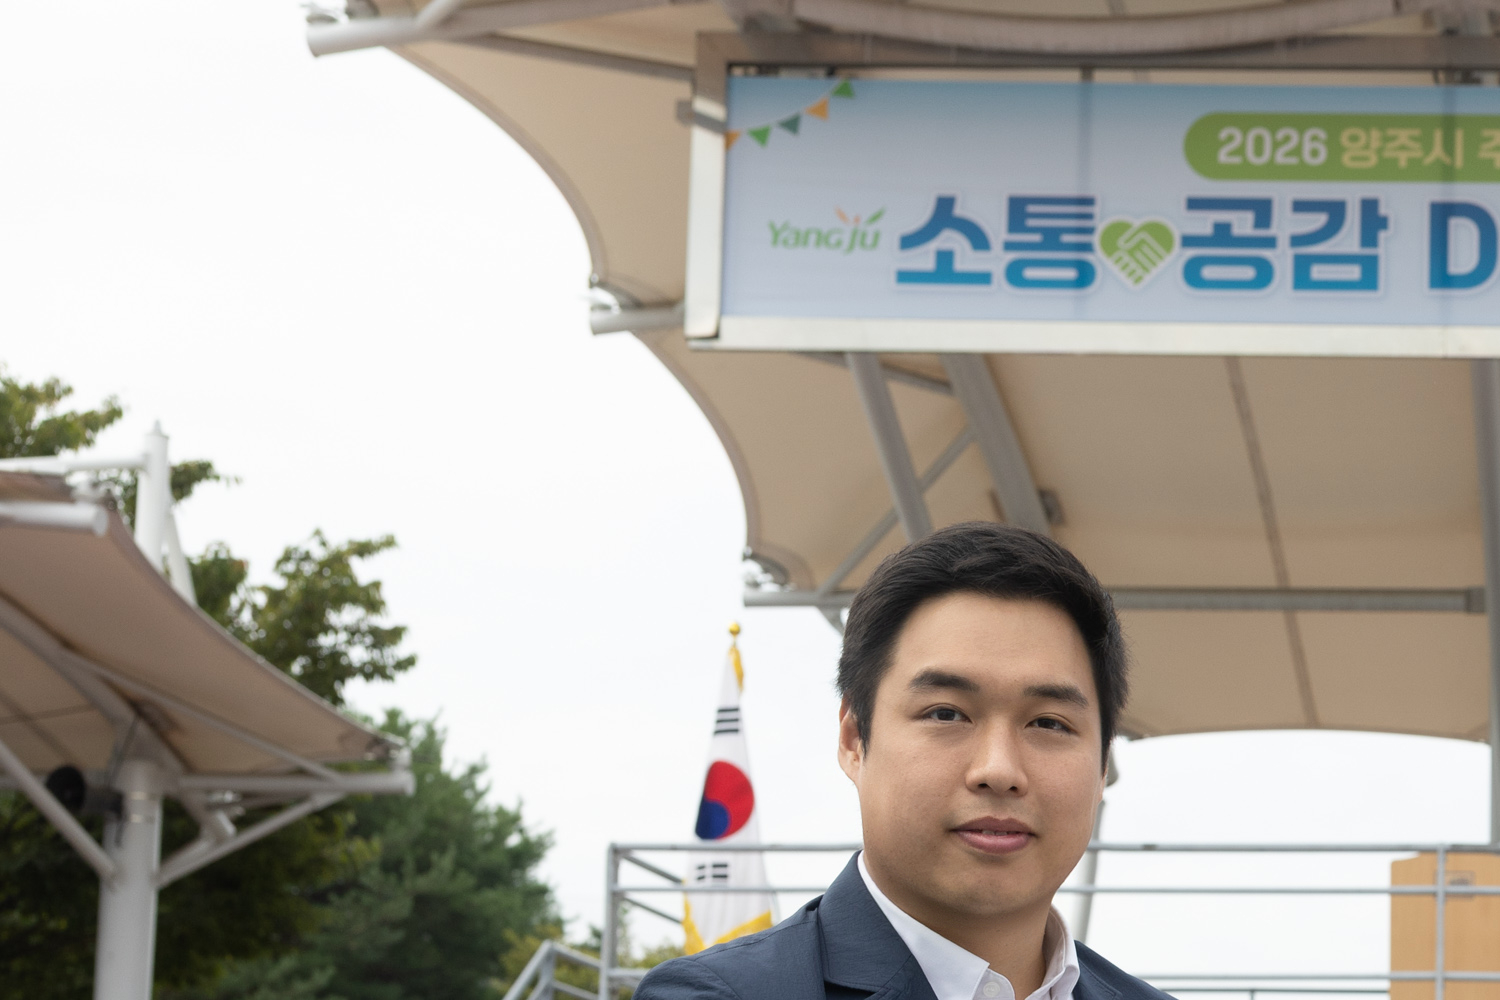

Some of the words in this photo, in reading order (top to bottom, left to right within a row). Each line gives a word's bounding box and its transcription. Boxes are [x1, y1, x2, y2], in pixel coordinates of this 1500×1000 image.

[1217, 127, 1328, 165] 2026
[1340, 126, 1464, 170] 양주시
[895, 196, 1096, 290] 소통
[1181, 196, 1389, 292] 공감
